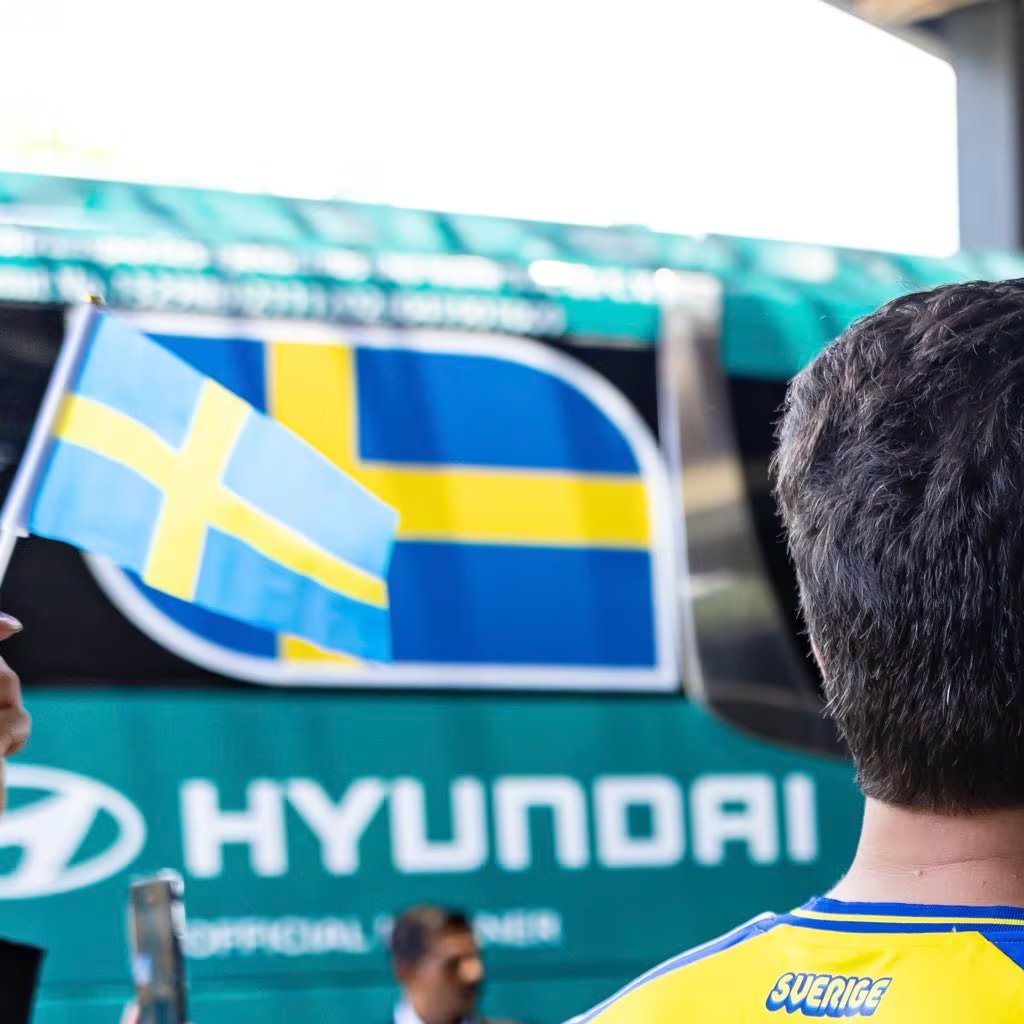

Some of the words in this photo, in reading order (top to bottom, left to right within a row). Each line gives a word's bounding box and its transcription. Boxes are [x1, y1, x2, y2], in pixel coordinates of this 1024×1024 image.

[180, 773, 818, 878] HYUNDAI
[182, 915, 367, 958] OFFICIAL
[765, 972, 893, 1018] SVERIGE
